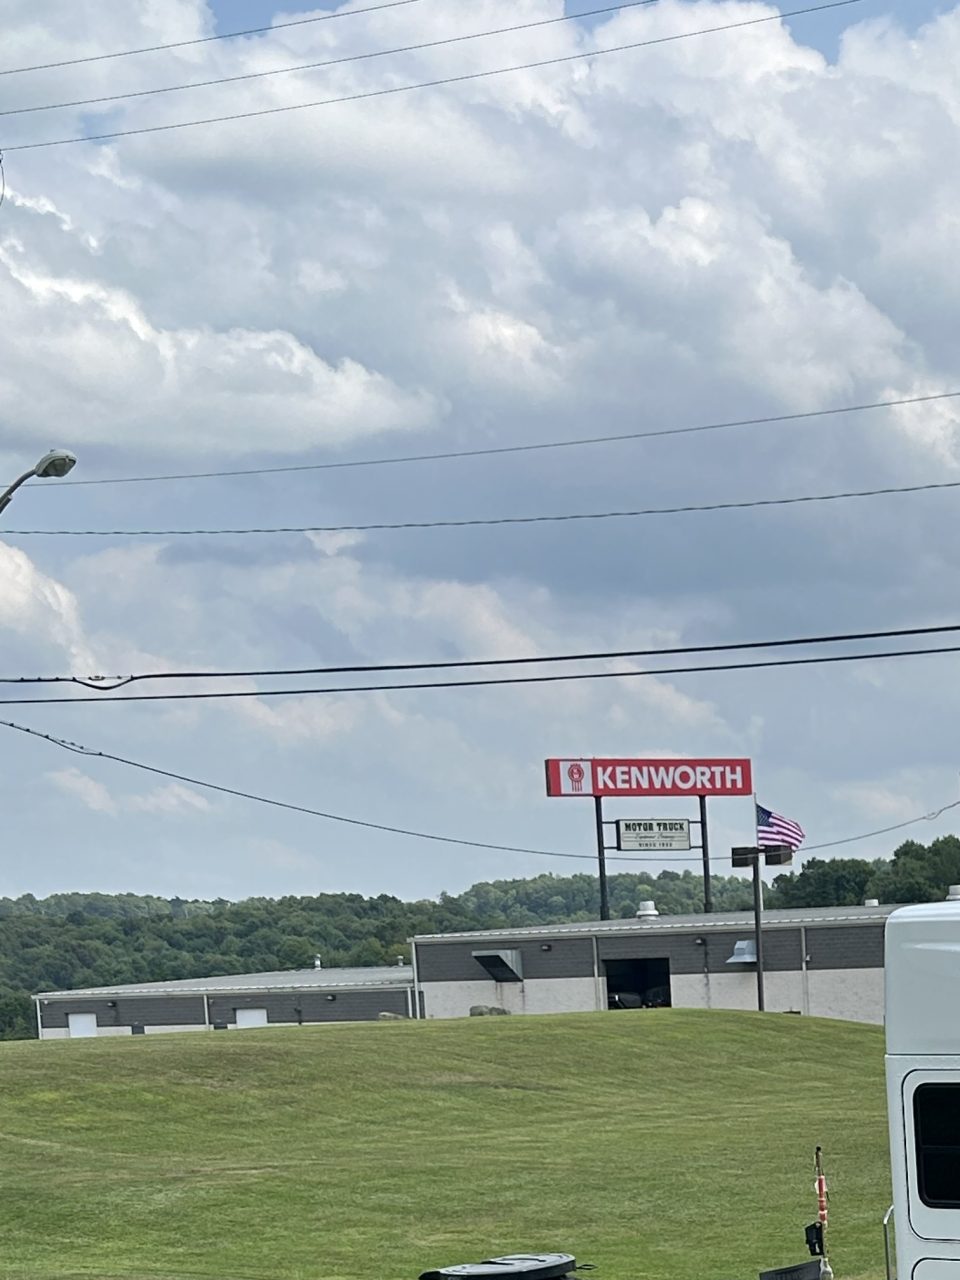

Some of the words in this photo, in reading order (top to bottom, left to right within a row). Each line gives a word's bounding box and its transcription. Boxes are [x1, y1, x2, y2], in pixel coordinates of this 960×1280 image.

[597, 765, 742, 789] KENWORTH
[624, 822, 654, 832] MOTOR
[656, 822, 685, 832] TRUCK
